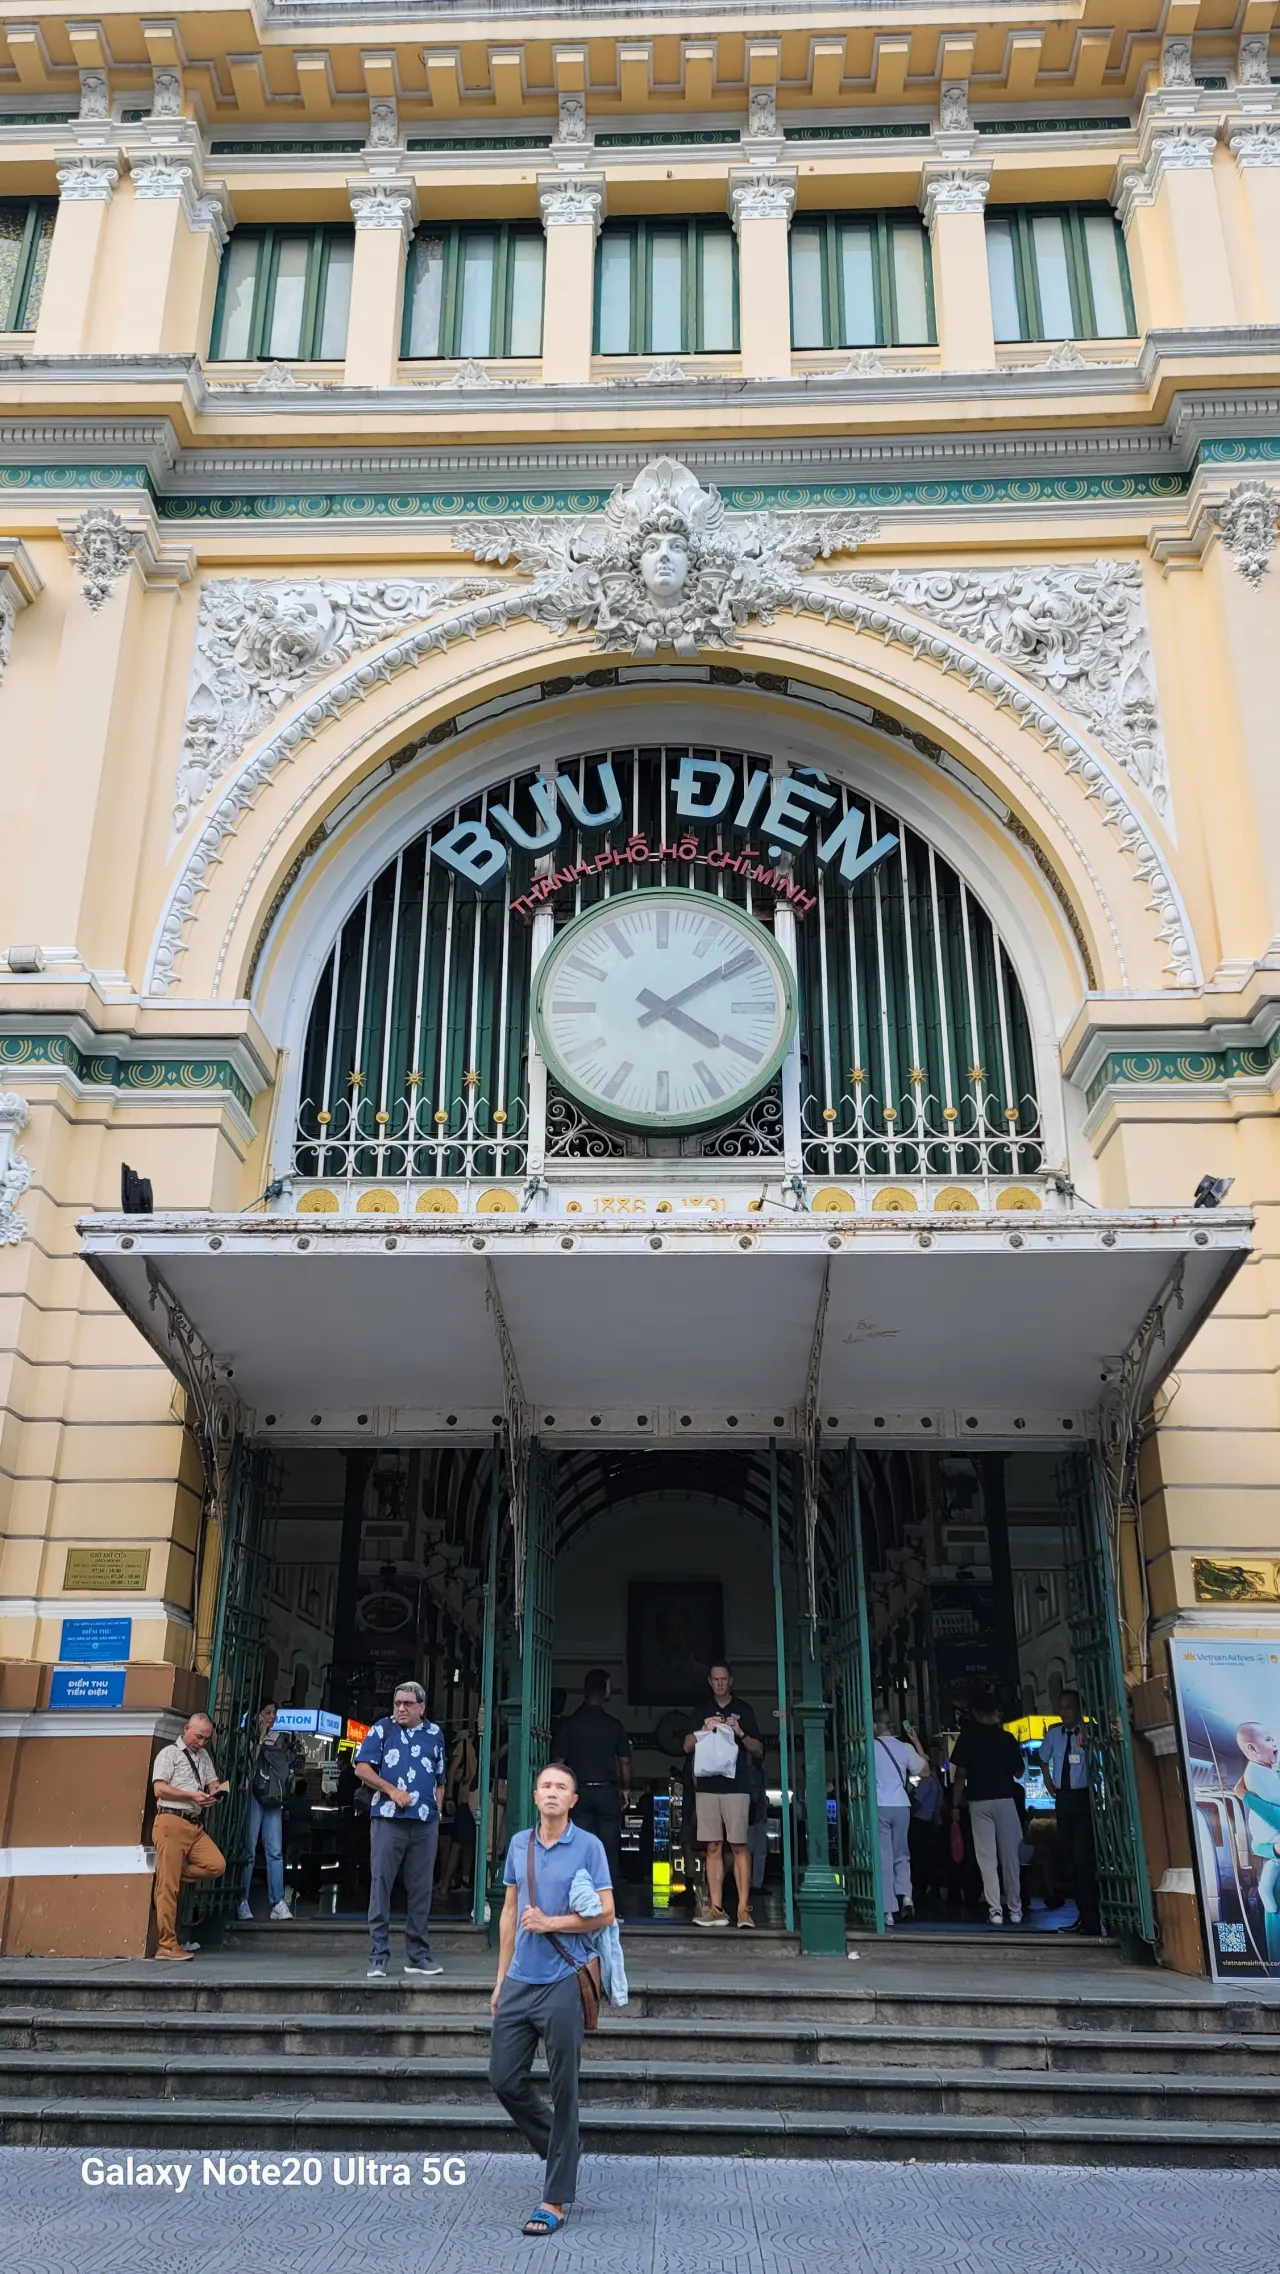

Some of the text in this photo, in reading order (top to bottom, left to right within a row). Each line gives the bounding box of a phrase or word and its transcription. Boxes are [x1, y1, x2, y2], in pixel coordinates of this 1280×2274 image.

[430, 757, 900, 887] BƯU ĐIỆN
[594, 832, 650, 871] PHỐ
[659, 833, 699, 860] HỒ
[706, 849, 760, 875] CHÍ
[753, 864, 817, 910] MINH
[87, 1688, 108, 1697] ĐIỆN
